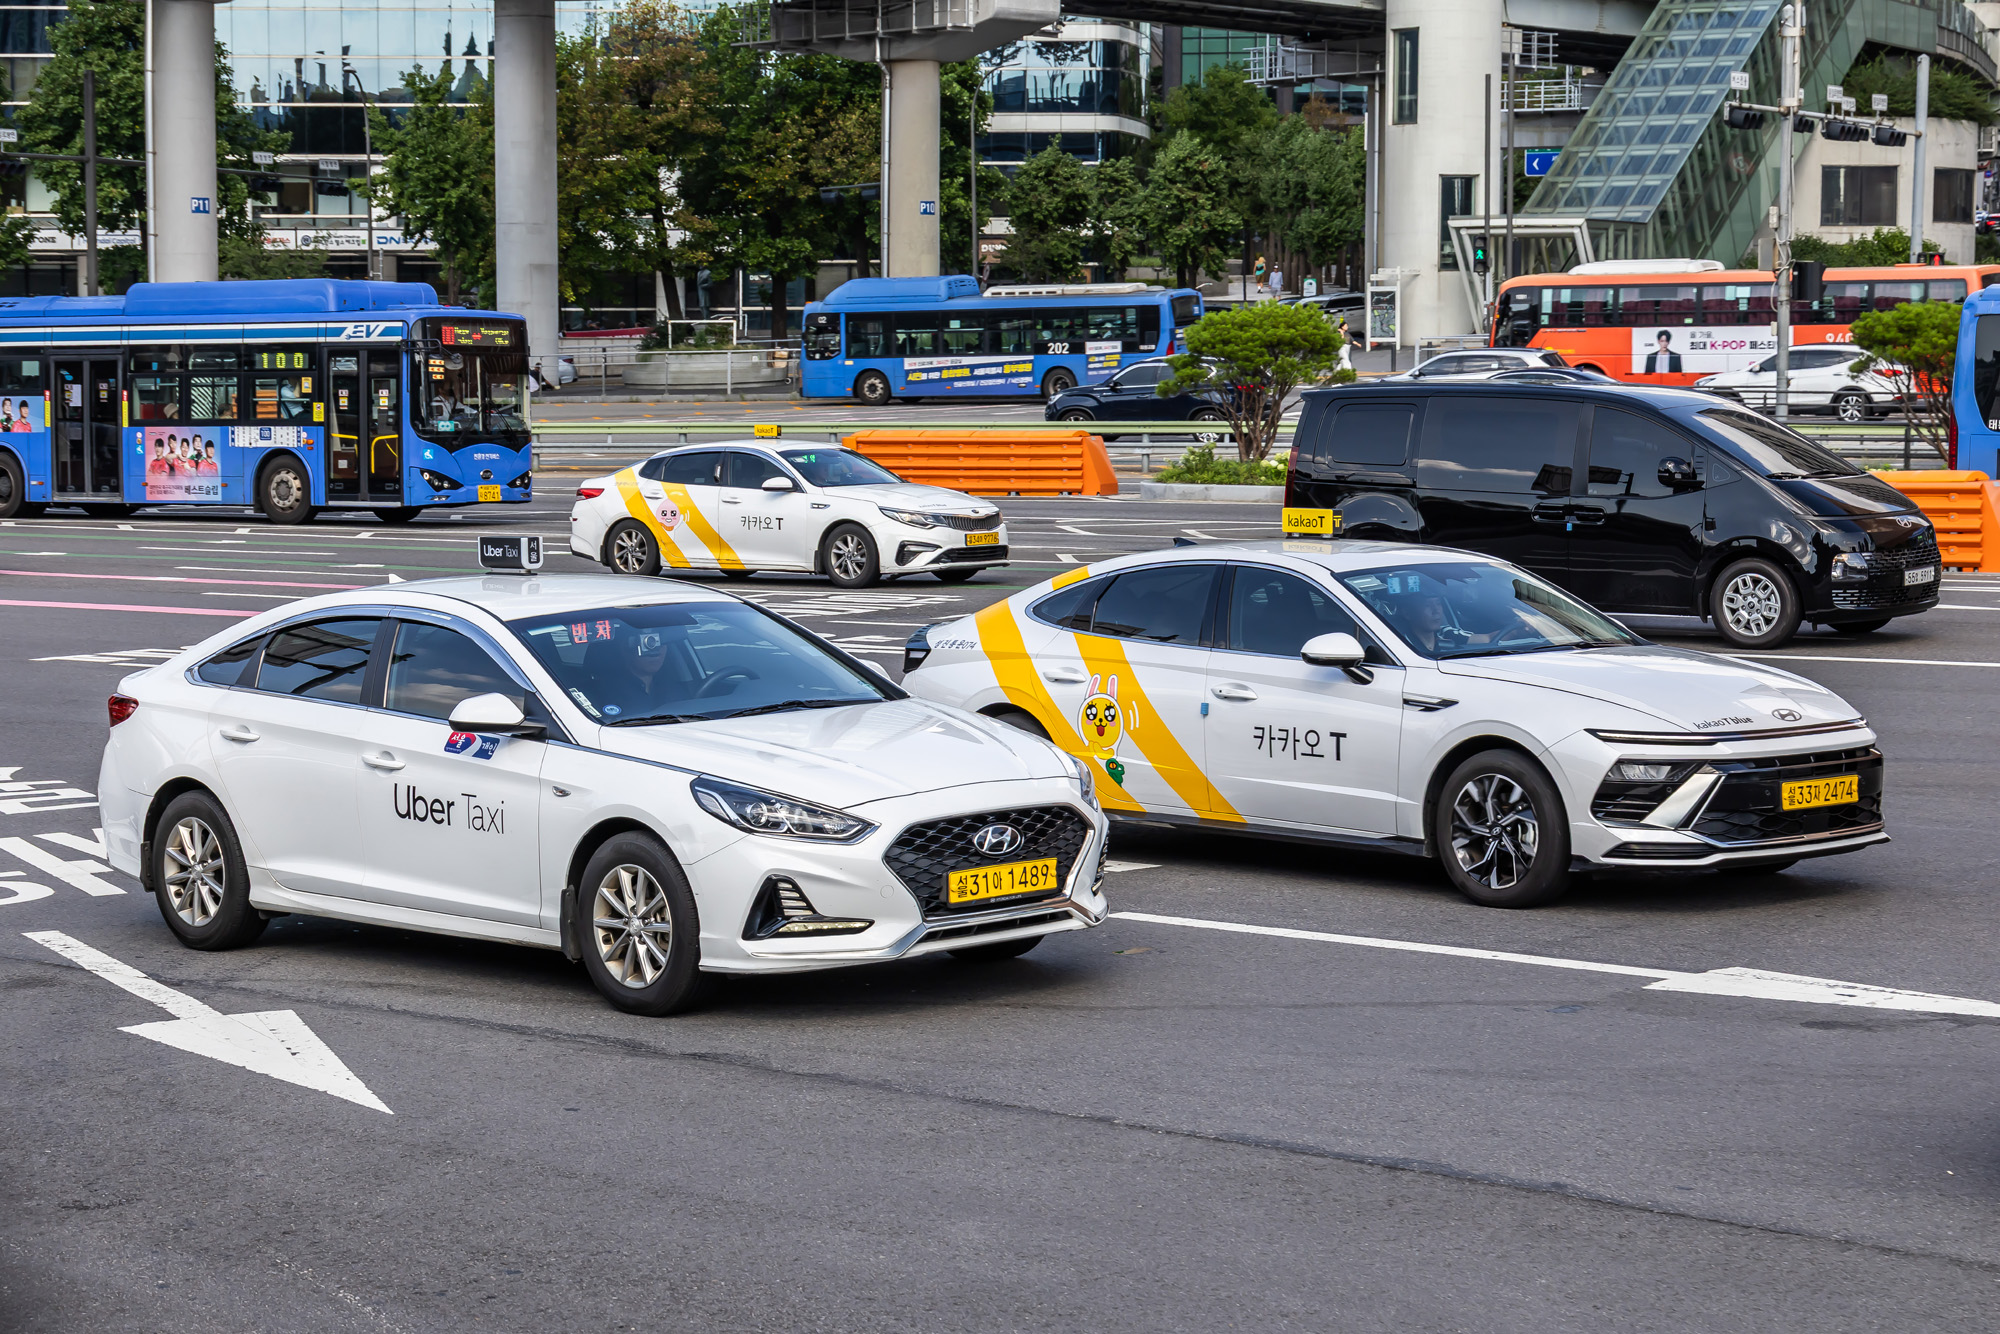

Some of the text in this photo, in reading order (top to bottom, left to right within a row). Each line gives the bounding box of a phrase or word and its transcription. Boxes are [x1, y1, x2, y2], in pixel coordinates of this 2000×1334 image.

[192, 199, 209, 211] P11
[920, 203, 935, 213] P10
[351, 324, 380, 339] EV
[1047, 342, 1070, 354] 202
[1690, 340, 1776, 350] 최대 K-POP 페스티
[262, 353, 304, 368] 100
[184, 485, 219, 496] 베스트슬립
[741, 515, 784, 531] 카카오 T
[483, 544, 519, 557] Uber Taxi
[530, 540, 538, 562] 서울
[450, 733, 466, 748] 서울
[1253, 724, 1347, 761] 카카오 T
[481, 742, 498, 755] 개인
[1823, 780, 1853, 802] 2474
[394, 783, 504, 834] Uber Taxi
[1008, 864, 1049, 889] 1489
